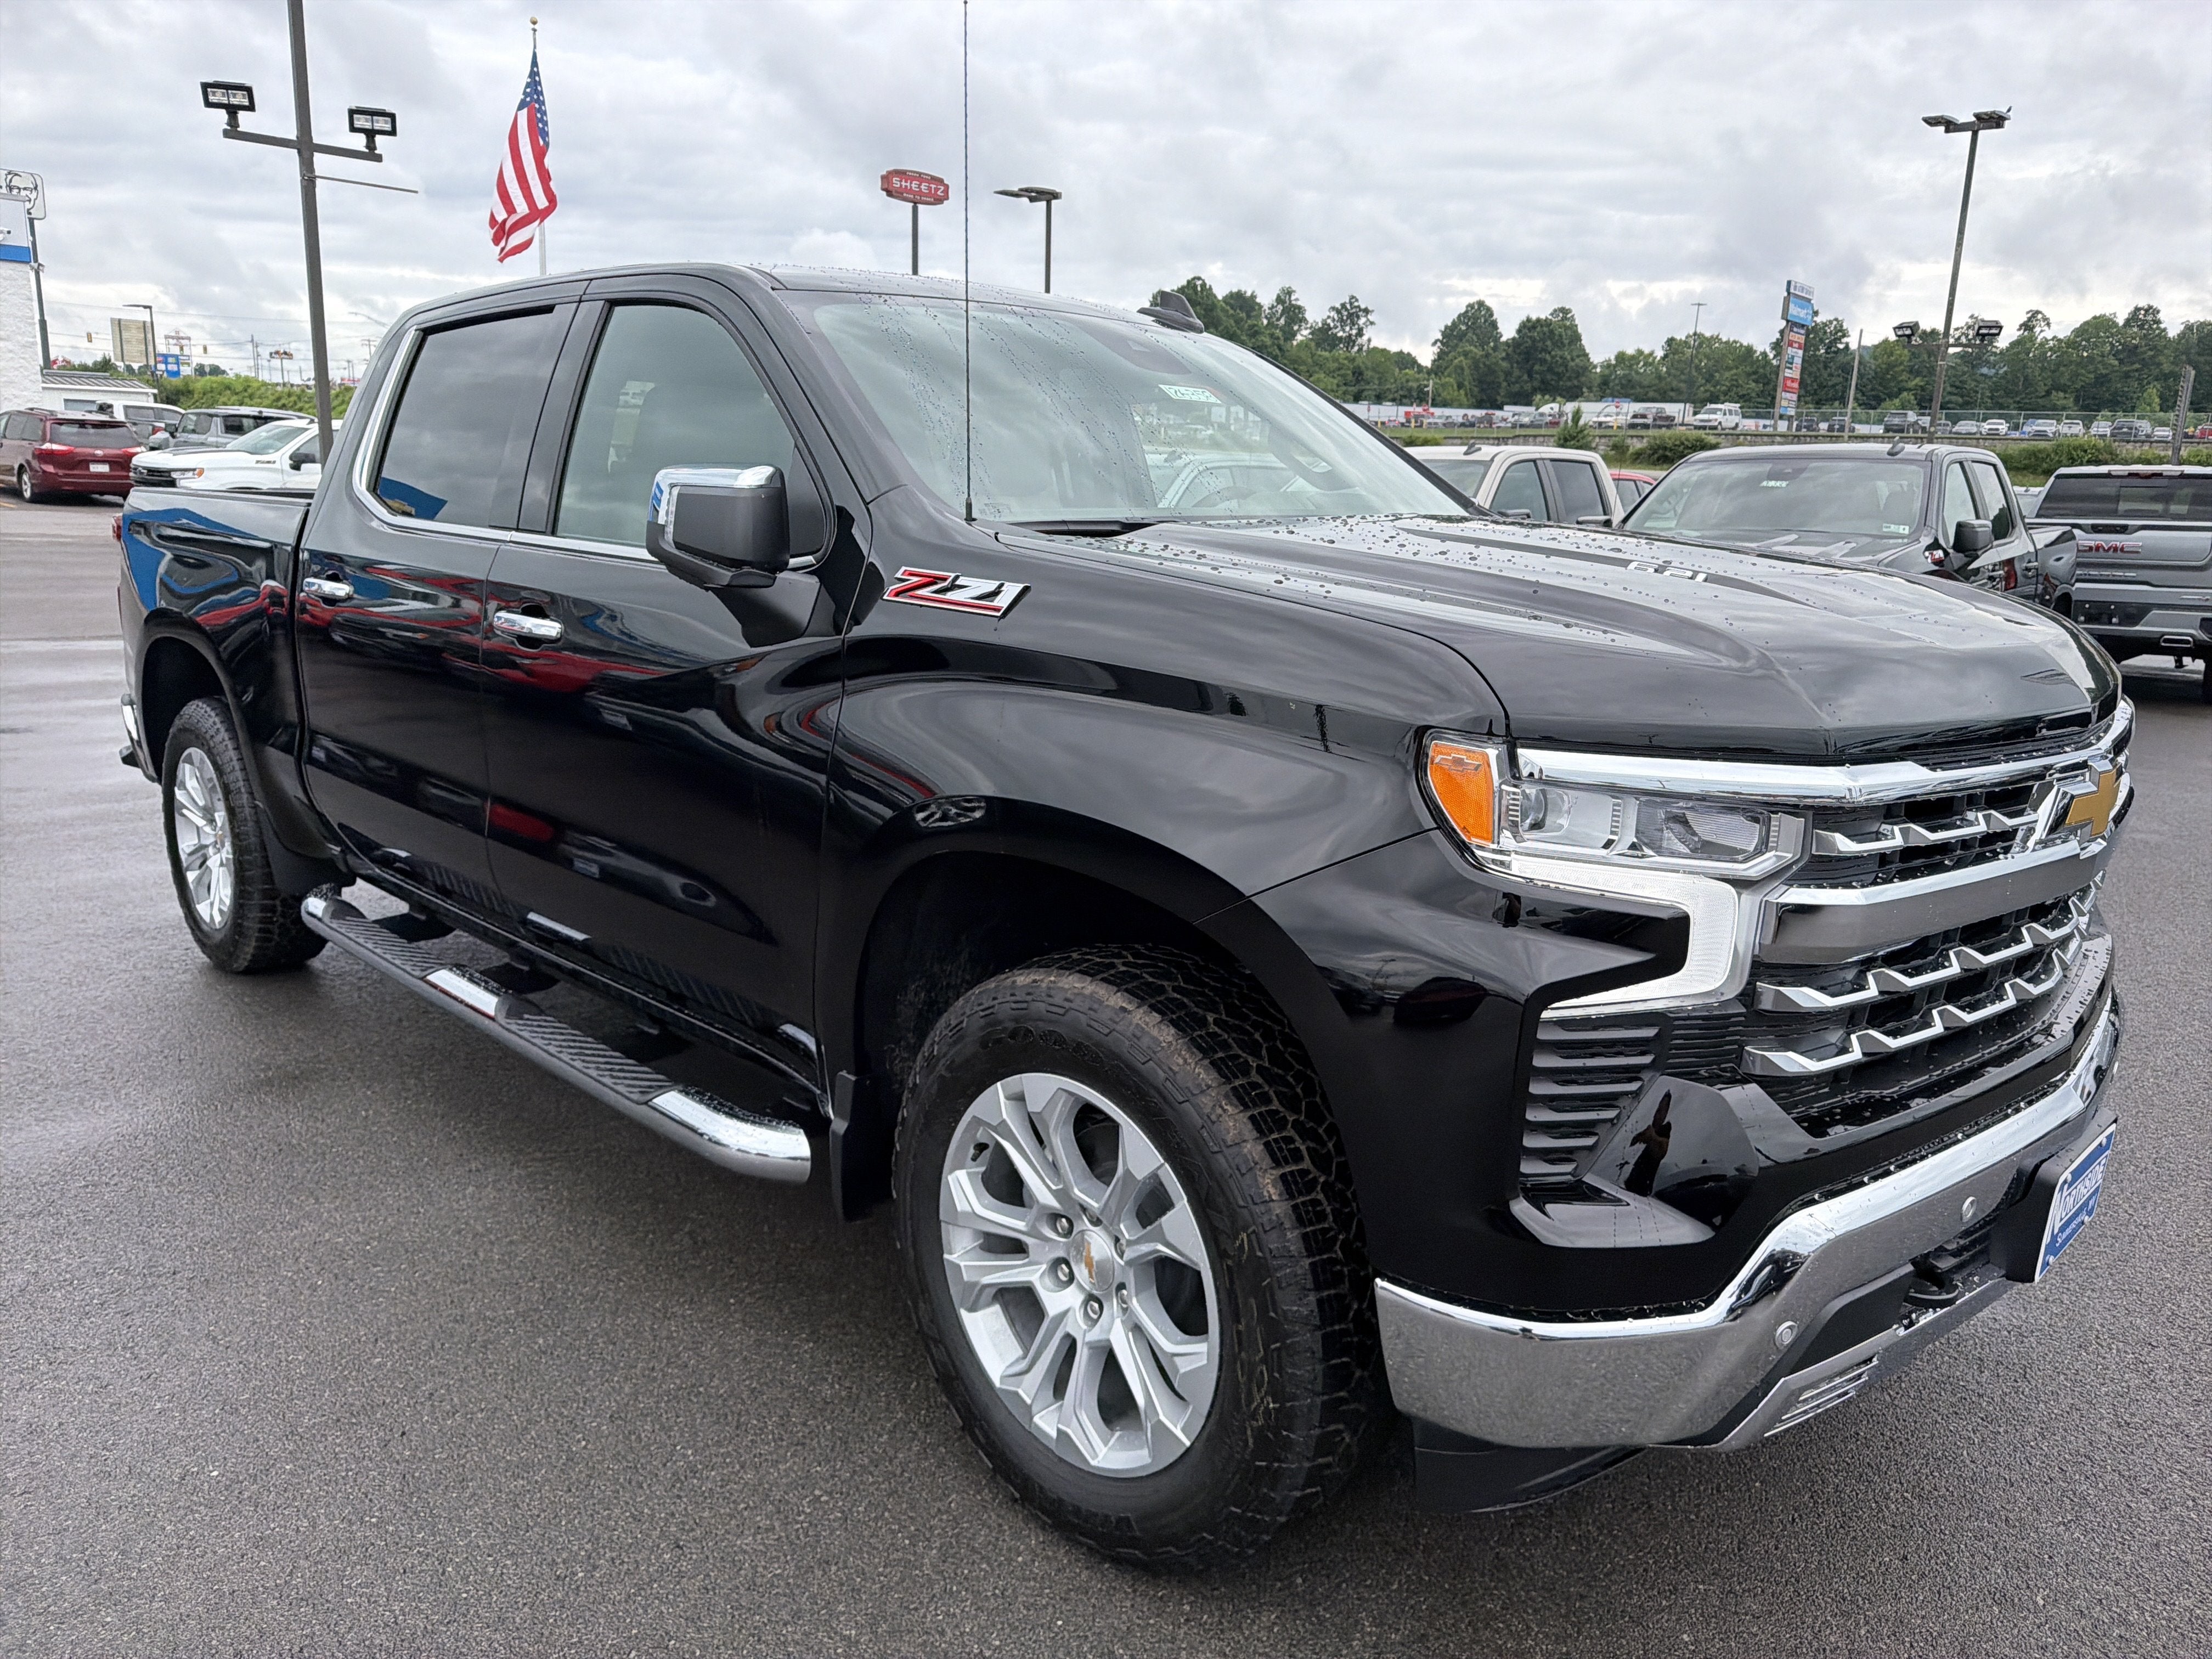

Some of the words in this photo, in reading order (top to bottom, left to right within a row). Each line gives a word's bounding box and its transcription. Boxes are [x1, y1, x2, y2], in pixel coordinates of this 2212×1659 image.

[892, 177, 945, 196] SHEETZ
[2078, 540, 2142, 554] GMC
[882, 566, 1032, 618] Z71
[2047, 1158, 2106, 1244] NORTHSIDE
